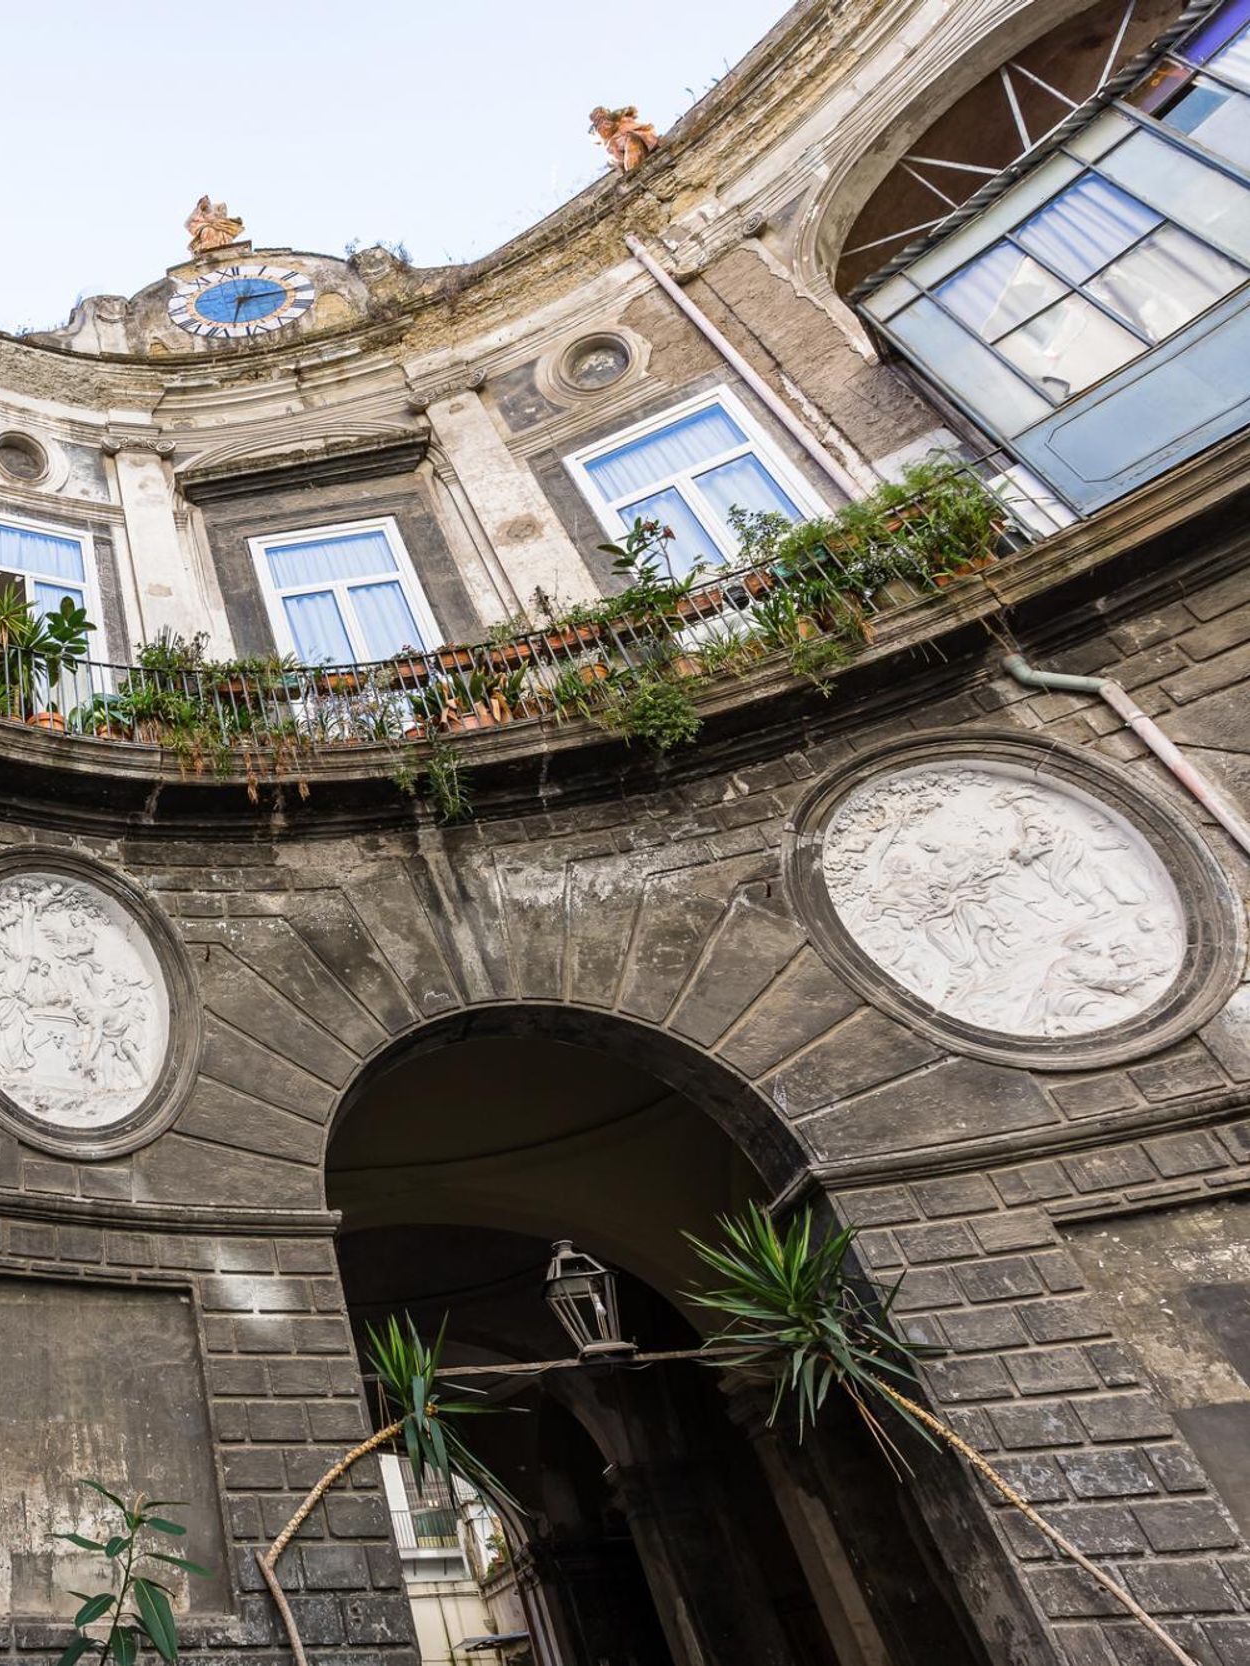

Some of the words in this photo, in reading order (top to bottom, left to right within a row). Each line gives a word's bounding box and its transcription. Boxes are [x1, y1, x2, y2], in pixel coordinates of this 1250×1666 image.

[215, 266, 240, 281] XII
[257, 265, 267, 277] I
[280, 271, 299, 281] II
[277, 316, 298, 327] V
[245, 325, 270, 336] VI
